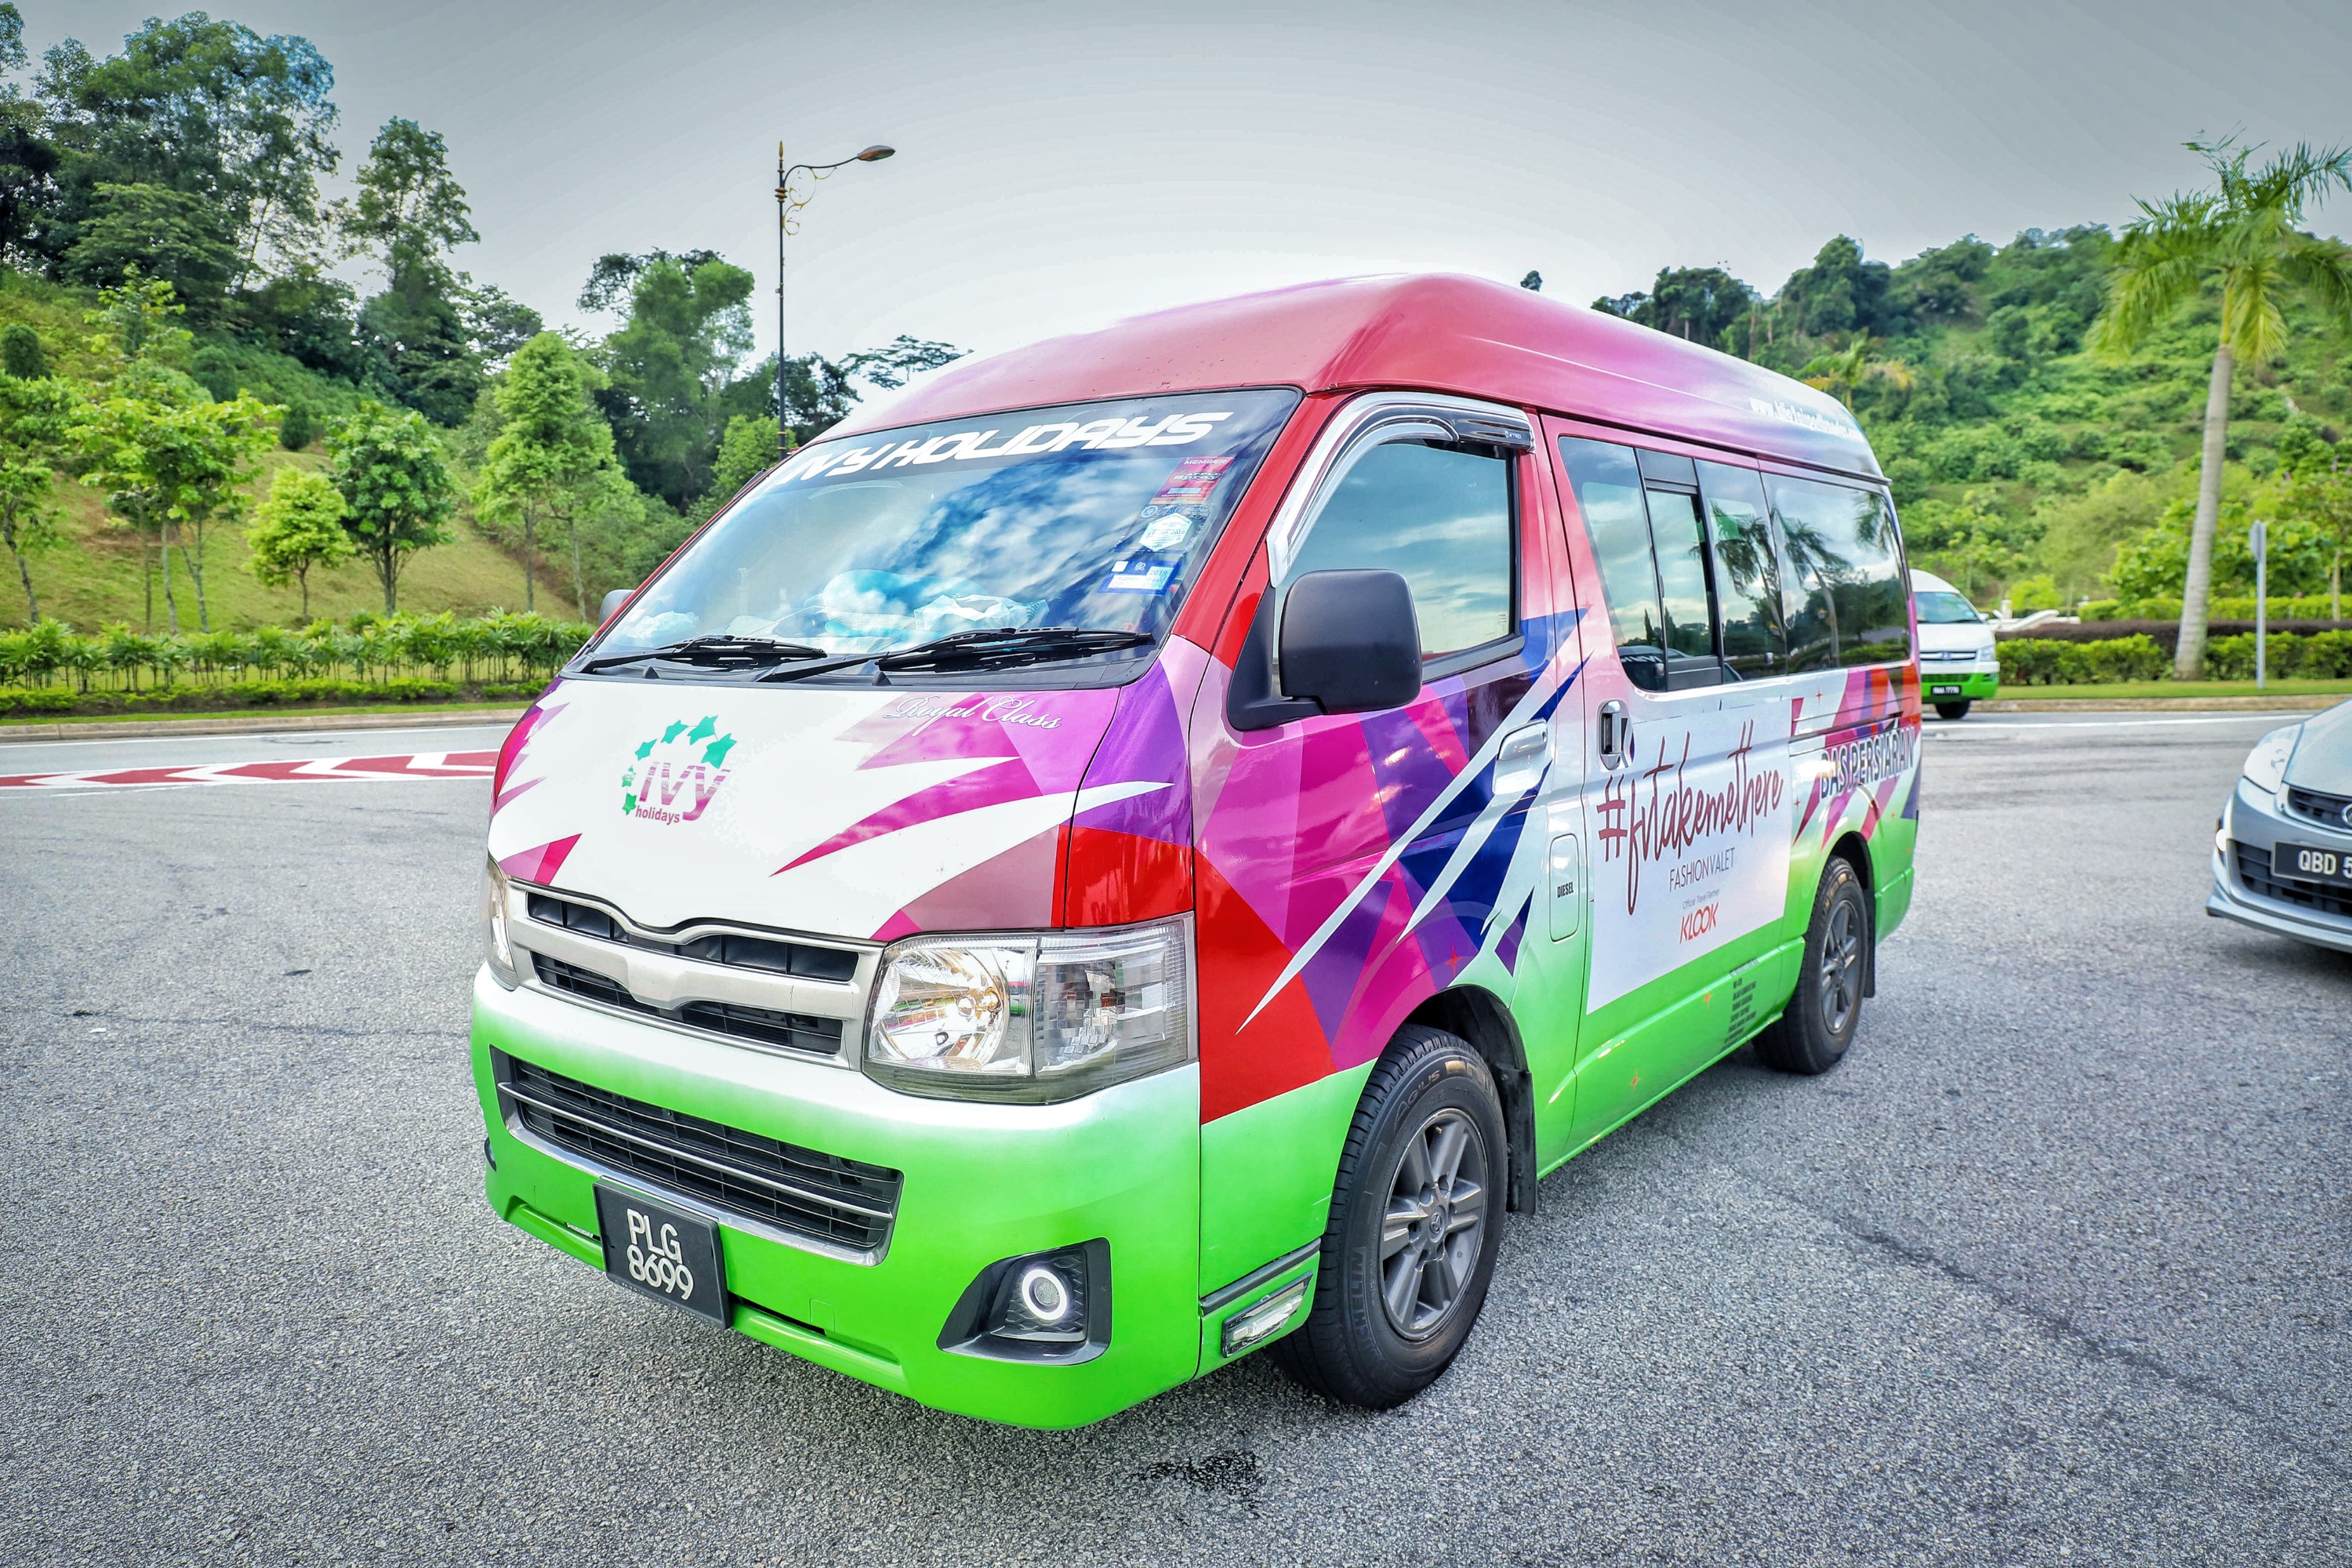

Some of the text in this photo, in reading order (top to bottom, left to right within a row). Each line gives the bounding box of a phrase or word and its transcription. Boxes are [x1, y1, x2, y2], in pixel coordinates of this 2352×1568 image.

[869, 412, 1233, 470] HOLIDAYS
[883, 695, 1062, 737] Royal Class
[1849, 726, 1915, 787] PERSIARAN
[635, 805, 681, 826] holidays
[2298, 850, 2336, 875] QBD
[1557, 881, 1573, 898] DIESEL
[1679, 902, 1719, 944] KLOOK
[627, 1208, 684, 1265] PLG
[627, 1245, 694, 1301] 8699
